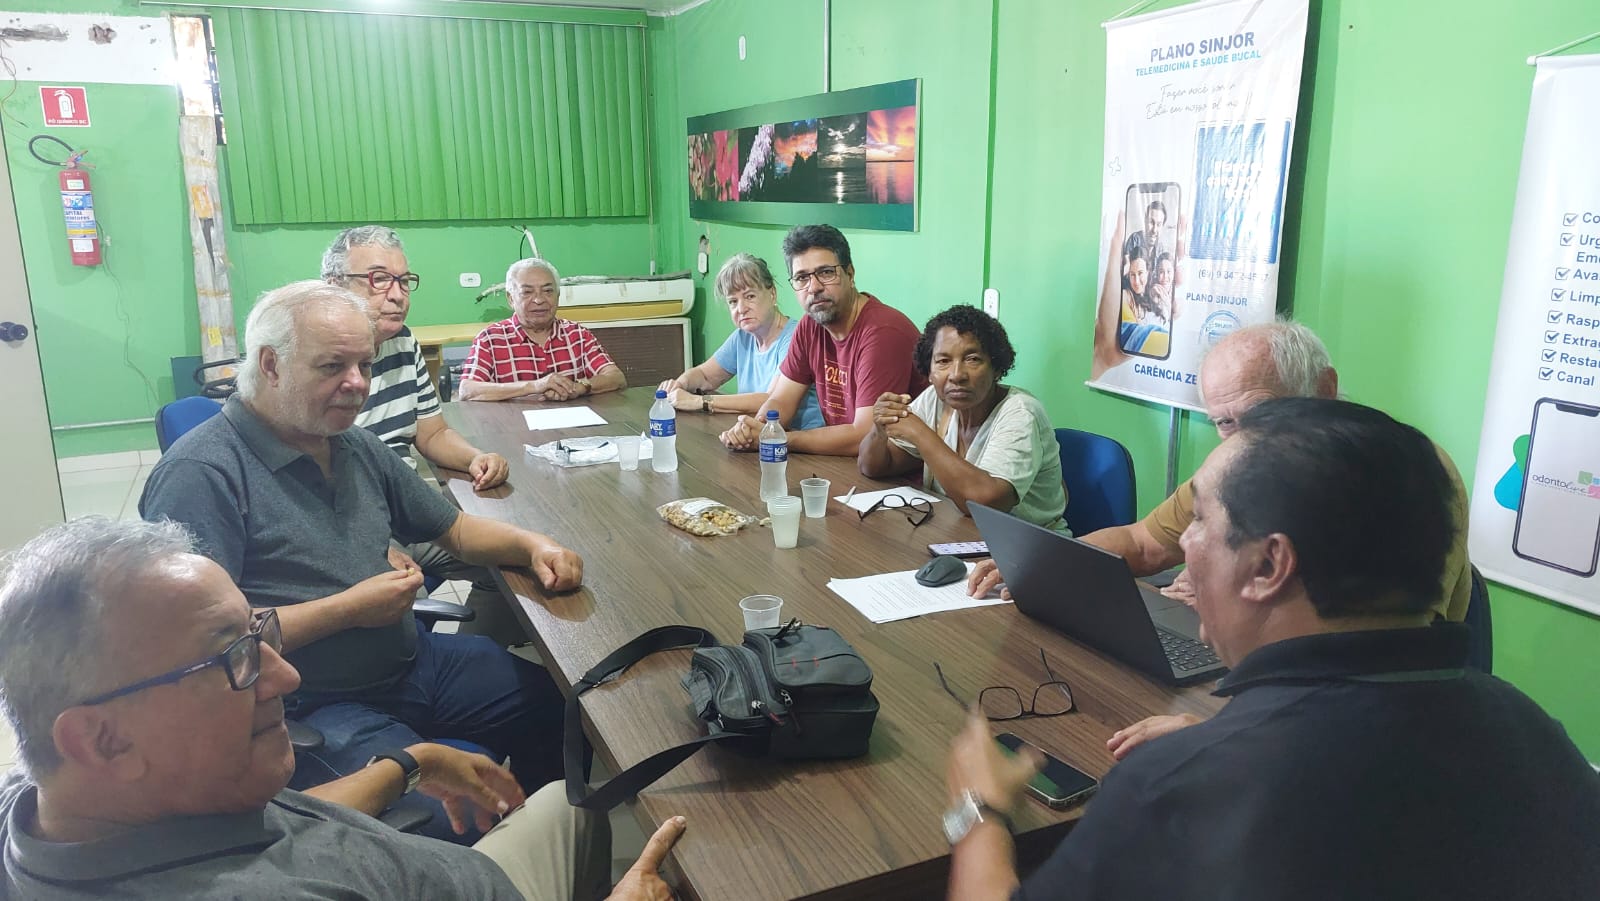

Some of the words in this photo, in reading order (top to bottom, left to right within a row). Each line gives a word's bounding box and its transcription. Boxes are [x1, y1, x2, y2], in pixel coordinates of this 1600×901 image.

[1150, 42, 1195, 63] PLANO
[1199, 31, 1255, 55] SINJOR
[1135, 61, 1191, 77] TELEMEDICINA
[1192, 60, 1198, 69] E
[1232, 49, 1262, 64] BUCAL
[1576, 251, 1600, 264] Em
[1573, 268, 1600, 281] Ava
[1186, 292, 1213, 303] PLANO
[1215, 294, 1248, 307] SINJOR
[1562, 333, 1600, 348] Extra
[1560, 352, 1600, 369] Resta
[1557, 370, 1595, 386] Canal
